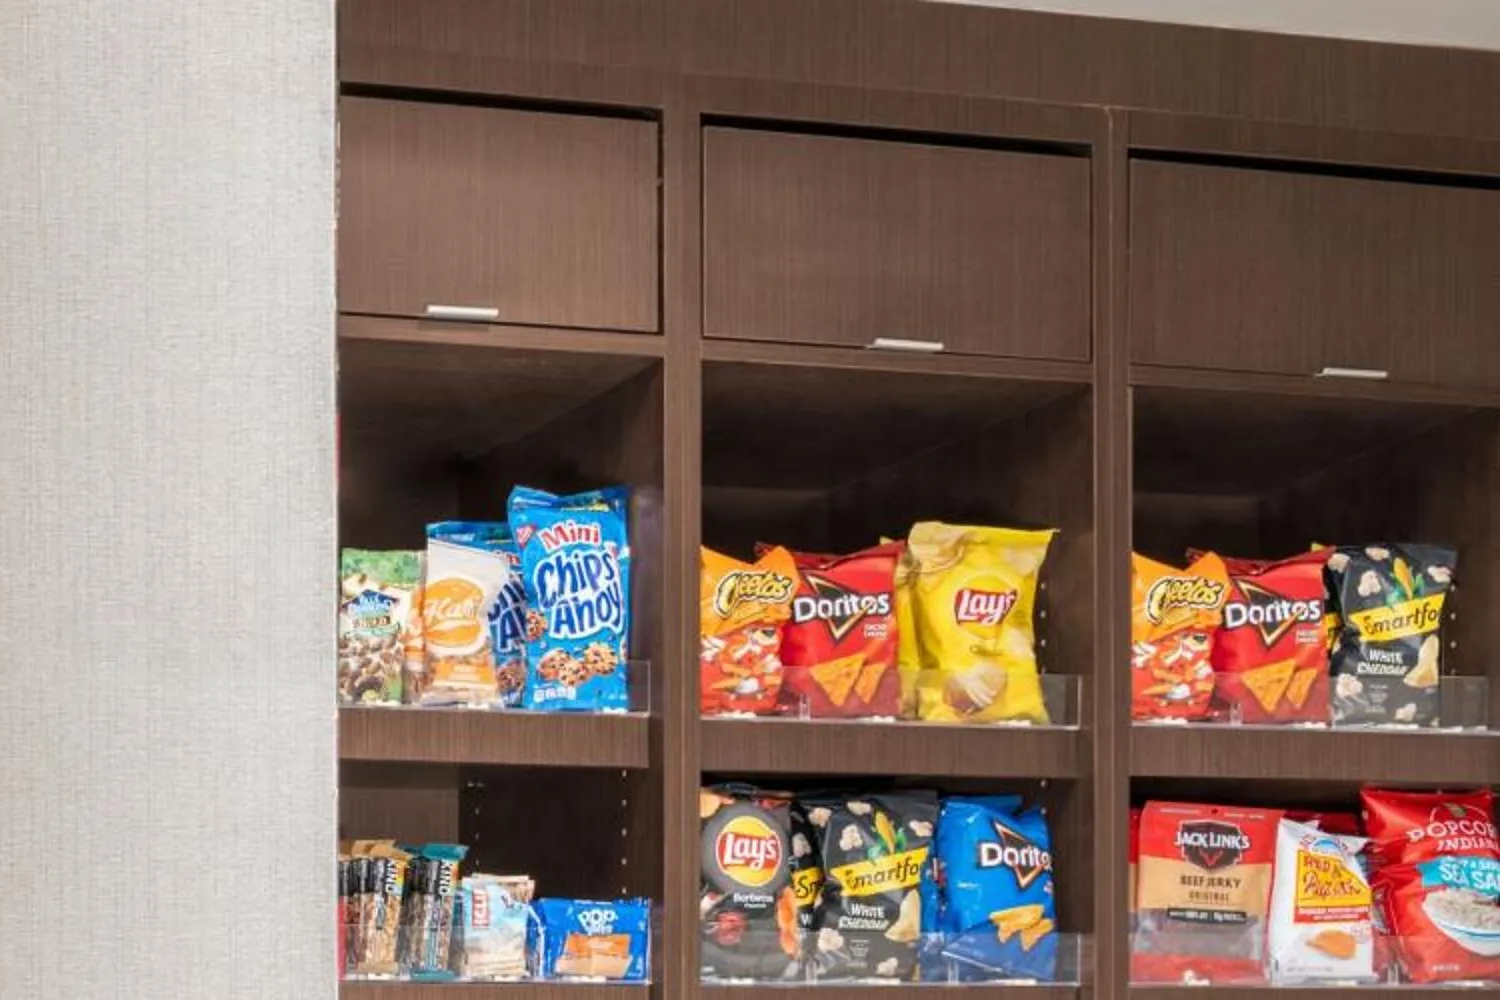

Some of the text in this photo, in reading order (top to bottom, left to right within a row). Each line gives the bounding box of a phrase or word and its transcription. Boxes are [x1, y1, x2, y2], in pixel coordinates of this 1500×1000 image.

[541, 521, 599, 551] Mini
[536, 551, 615, 608] Chips
[793, 593, 890, 623] Doritos
[1225, 599, 1321, 629] Doritos
[723, 834, 777, 868] Lay's
[1180, 875, 1204, 887] BEEF
